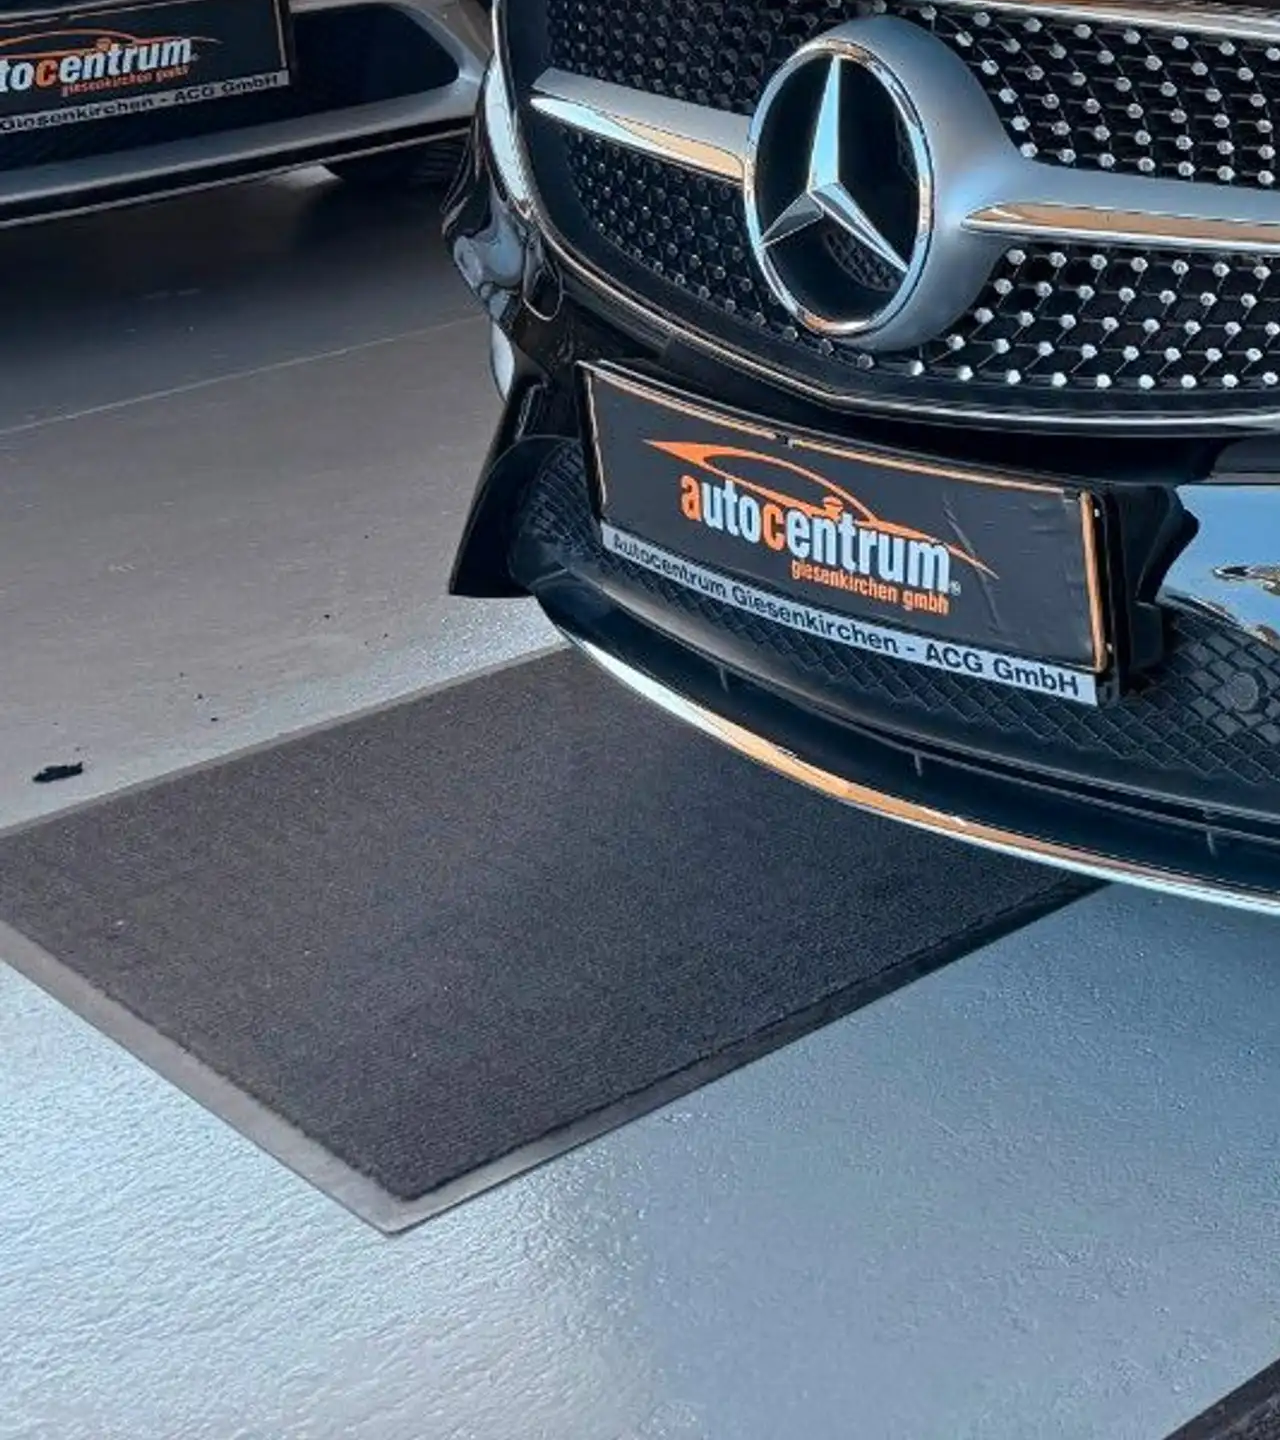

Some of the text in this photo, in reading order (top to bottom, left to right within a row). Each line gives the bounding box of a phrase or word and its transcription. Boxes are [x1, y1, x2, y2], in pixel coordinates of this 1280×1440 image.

[174, 86, 215, 104] ACG
[222, 74, 279, 96] GmbH
[680, 474, 949, 593] autocentrum
[613, 532, 728, 598] Autocentrum
[731, 584, 899, 654] Giesenkirchen
[925, 644, 984, 674] ACG
[993, 657, 1079, 697] GmbH
[791, 560, 949, 616] giesenkirchen gmbh
